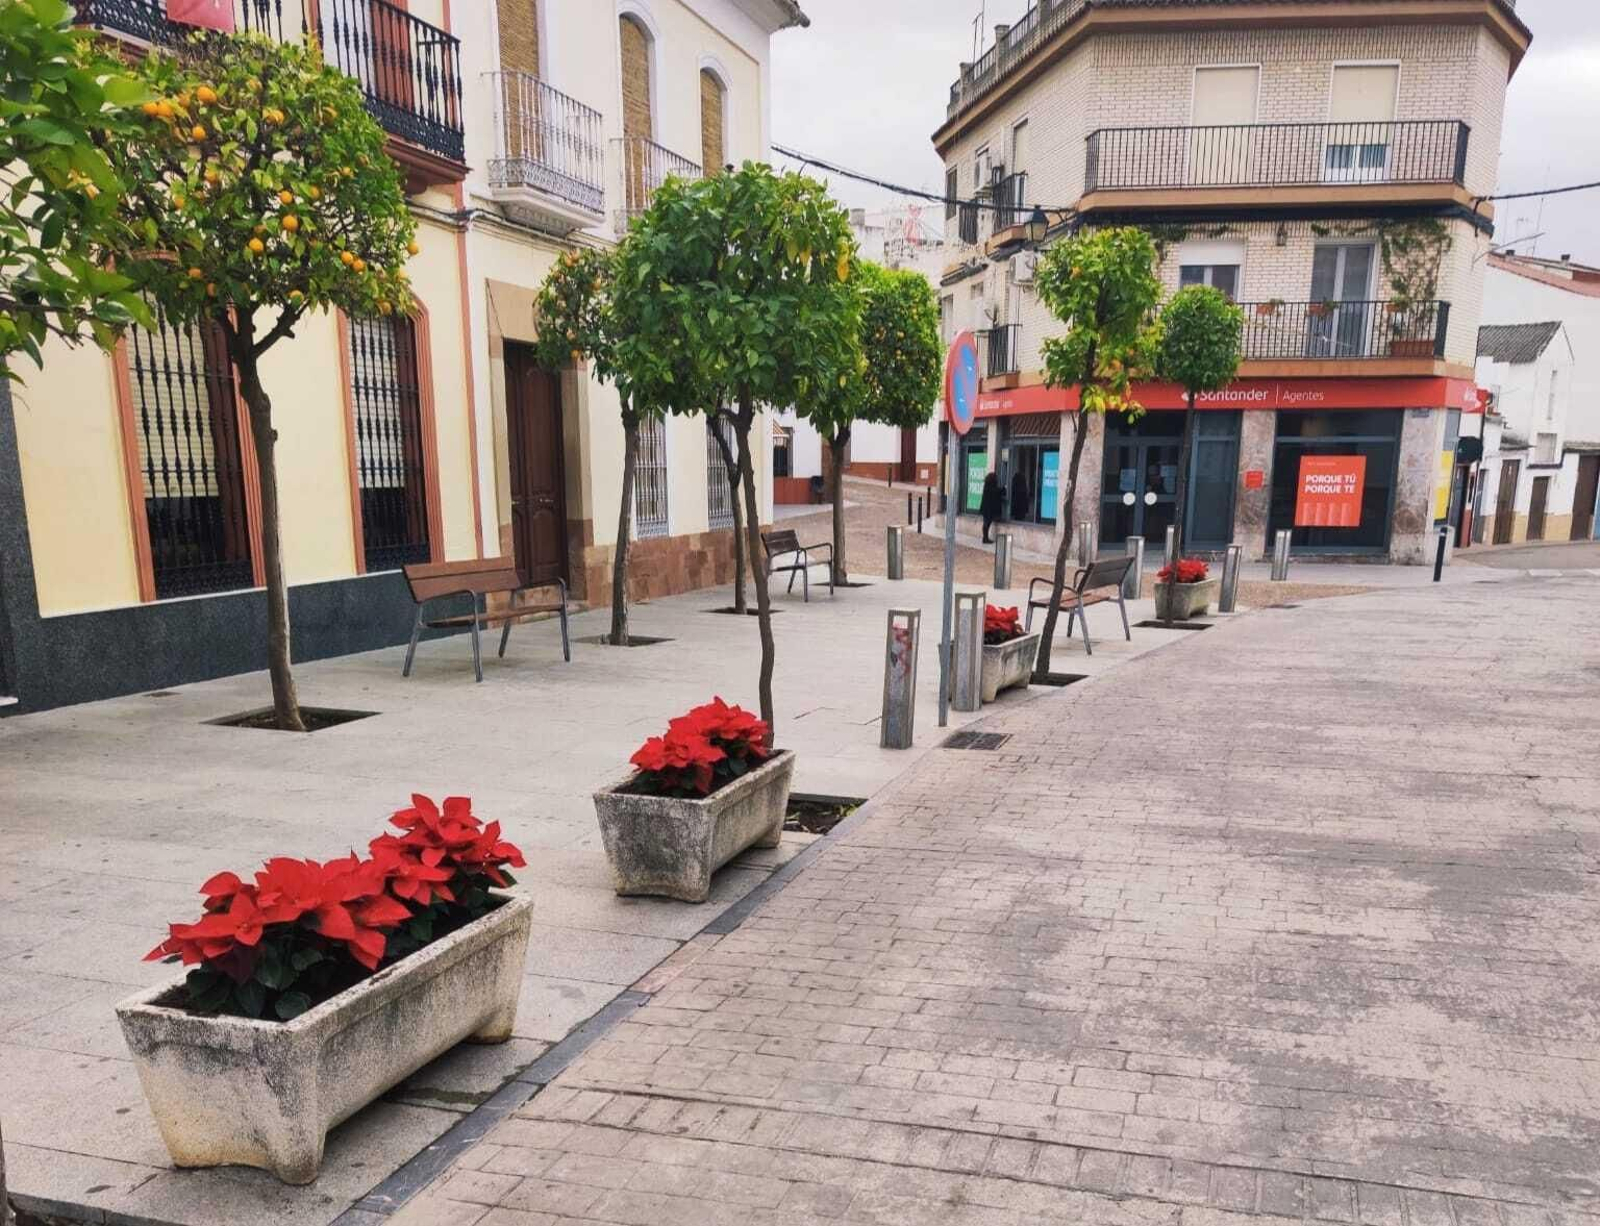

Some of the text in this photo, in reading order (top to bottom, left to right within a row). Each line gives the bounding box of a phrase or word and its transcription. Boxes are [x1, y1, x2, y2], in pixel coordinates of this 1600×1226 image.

[1200, 387, 1325, 403] Santander Agentes
[1305, 474, 1342, 484] PORQUE
[1304, 485, 1341, 494] PORQUE
